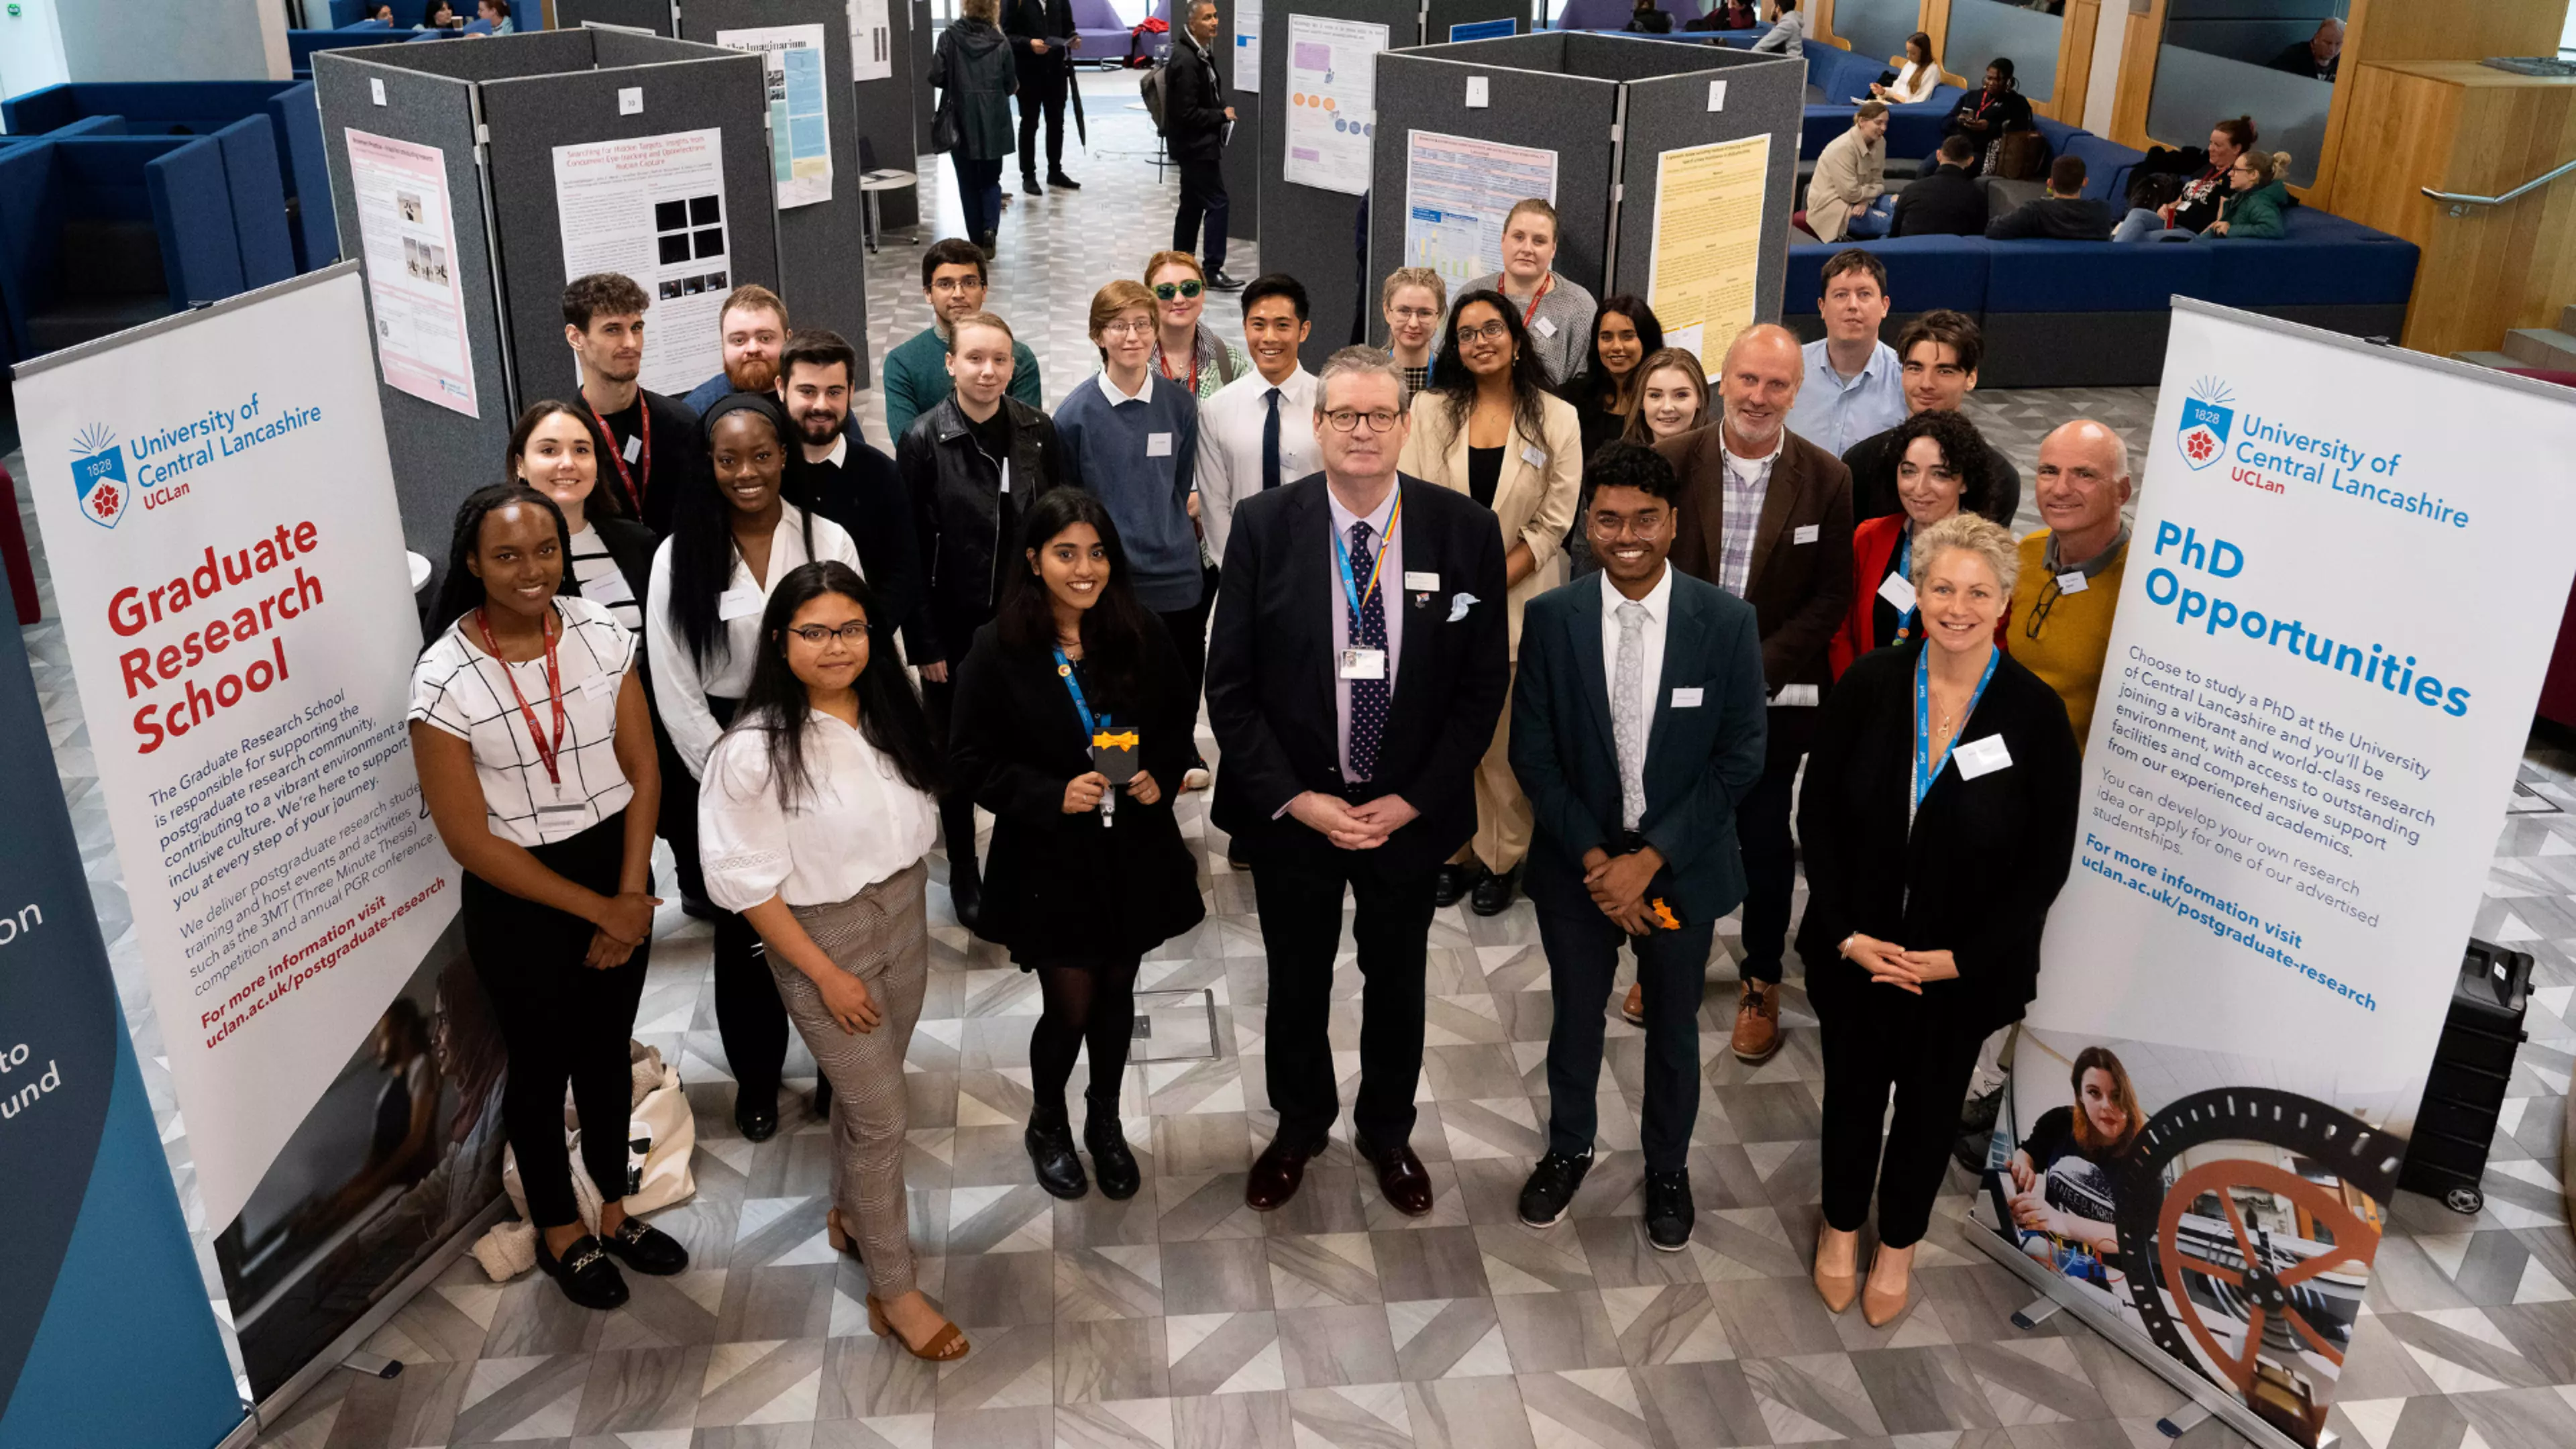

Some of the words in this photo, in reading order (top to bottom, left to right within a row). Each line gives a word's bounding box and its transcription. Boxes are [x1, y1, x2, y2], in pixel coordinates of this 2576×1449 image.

[746, 39, 807, 52] Imaginarium
[639, 158, 665, 168] Capture
[649, 150, 661, 158] and
[87, 458, 112, 478] 1828
[130, 409, 235, 461] University
[240, 392, 259, 420] of
[138, 439, 215, 488] Central
[219, 407, 321, 457] Lancashire
[2195, 408, 2220, 425] 1828
[2243, 413, 2365, 472] University
[2370, 453, 2402, 477] of
[143, 482, 190, 511] UCLan
[2231, 466, 2285, 494] UCLan
[2236, 441, 2326, 484] Central
[2331, 468, 2469, 528] Lancashire
[108, 521, 318, 637] Graduate
[2154, 520, 2244, 578] PhD
[119, 566, 324, 699] Research
[2145, 568, 2471, 717] Opportunities
[133, 636, 289, 754] School
[148, 786, 177, 807] The
[179, 749, 238, 790] Graduate
[241, 714, 303, 753] Research
[305, 688, 345, 721] School
[2118, 686, 2167, 716] joining
[2171, 707, 2180, 718] a
[2184, 712, 2237, 741] vibrant
[2239, 735, 2269, 754] and
[2273, 749, 2361, 794] world-class
[2365, 788, 2434, 826] research
[2125, 666, 2139, 679] of
[2141, 672, 2194, 702] Central
[2198, 693, 2276, 736] Lancashire
[2280, 731, 2312, 750] and
[2313, 744, 2359, 770] you'll
[2362, 759, 2383, 781] be
[2129, 645, 2182, 677] Choose
[2186, 669, 2201, 684] to
[2205, 678, 2247, 704] study
[2249, 696, 2259, 707] a
[2262, 698, 2295, 721] PhD
[2298, 716, 2315, 731] at
[2319, 721, 2345, 741] the
[2349, 733, 2430, 780] University
[154, 815, 167, 828] is
[170, 767, 244, 820] responsible
[245, 755, 266, 772] for
[269, 717, 338, 761] supporting
[339, 705, 359, 722] the
[160, 788, 246, 853] postgraduate
[249, 754, 306, 794] research
[309, 718, 376, 761] community,
[164, 812, 243, 867] contributing
[245, 802, 260, 816] to
[264, 796, 271, 807] a
[274, 768, 320, 800] vibrant
[323, 724, 395, 773] environment
[168, 846, 223, 888] inclusive
[227, 817, 276, 849] culture.
[276, 792, 316, 819] We're
[318, 775, 345, 797] here
[347, 766, 360, 779] to
[362, 737, 408, 771] support
[2108, 737, 2138, 761] from
[2142, 757, 2168, 773] our
[2170, 769, 2263, 816] experienced
[2265, 811, 2353, 857] academics.
[2112, 718, 2167, 753] facilities
[2171, 748, 2201, 767] and
[2204, 762, 2319, 819] comprehensive
[2323, 814, 2387, 851] support
[2116, 704, 2208, 752] environment,
[2214, 744, 2244, 765] with
[2247, 760, 2298, 788] access
[2302, 781, 2318, 797] to
[2322, 792, 2420, 846] outstanding
[173, 885, 199, 912] you
[202, 873, 215, 890] at
[216, 850, 250, 879] every
[253, 833, 282, 855] step
[285, 818, 299, 837] of
[301, 804, 330, 831] your
[333, 777, 379, 814] journey.
[179, 919, 203, 938] We
[206, 886, 247, 922] deliver
[250, 835, 336, 896] postgraduate
[339, 802, 387, 839] research
[390, 783, 421, 807] stude
[184, 919, 234, 959] training
[236, 896, 260, 923] and
[262, 881, 292, 905] host
[294, 855, 336, 886] events
[339, 835, 360, 861] and
[364, 808, 411, 845] activities
[2086, 833, 2111, 855] For
[2114, 850, 2157, 877] more
[2161, 871, 2259, 928] information
[2265, 922, 2302, 949] visit
[2092, 806, 2183, 855] studentships.
[2097, 789, 2125, 809] idea
[2129, 804, 2145, 816] or
[2147, 812, 2188, 839] apply
[2192, 827, 2212, 847] for
[2214, 843, 2243, 863] one
[2247, 858, 2264, 871] of
[2265, 867, 2293, 885] our
[2296, 881, 2379, 928] advertised
[2102, 767, 2125, 789] You
[2128, 784, 2153, 801] can
[2157, 794, 2217, 830] develop
[2218, 824, 2254, 846] your
[2257, 842, 2289, 863] own
[2294, 859, 2359, 896] research
[190, 950, 220, 978] such
[223, 939, 235, 955] as
[237, 924, 258, 943] the
[260, 899, 289, 928] 3MT
[292, 878, 333, 910] (Three
[335, 850, 376, 881] Minute
[378, 821, 417, 853] Thesis)
[195, 938, 269, 996] competition
[272, 916, 297, 942] and
[301, 888, 343, 924] annual
[344, 871, 370, 896] PGR
[372, 834, 436, 878] conference.
[2082, 855, 2376, 1012] uclan.ac.uk/postgraduate-research
[201, 1004, 225, 1029] For
[229, 975, 266, 1009] more
[269, 918, 356, 979] information
[358, 896, 386, 921] visit
[207, 877, 445, 1049] uclan.ac.uk/postgraduate-research
